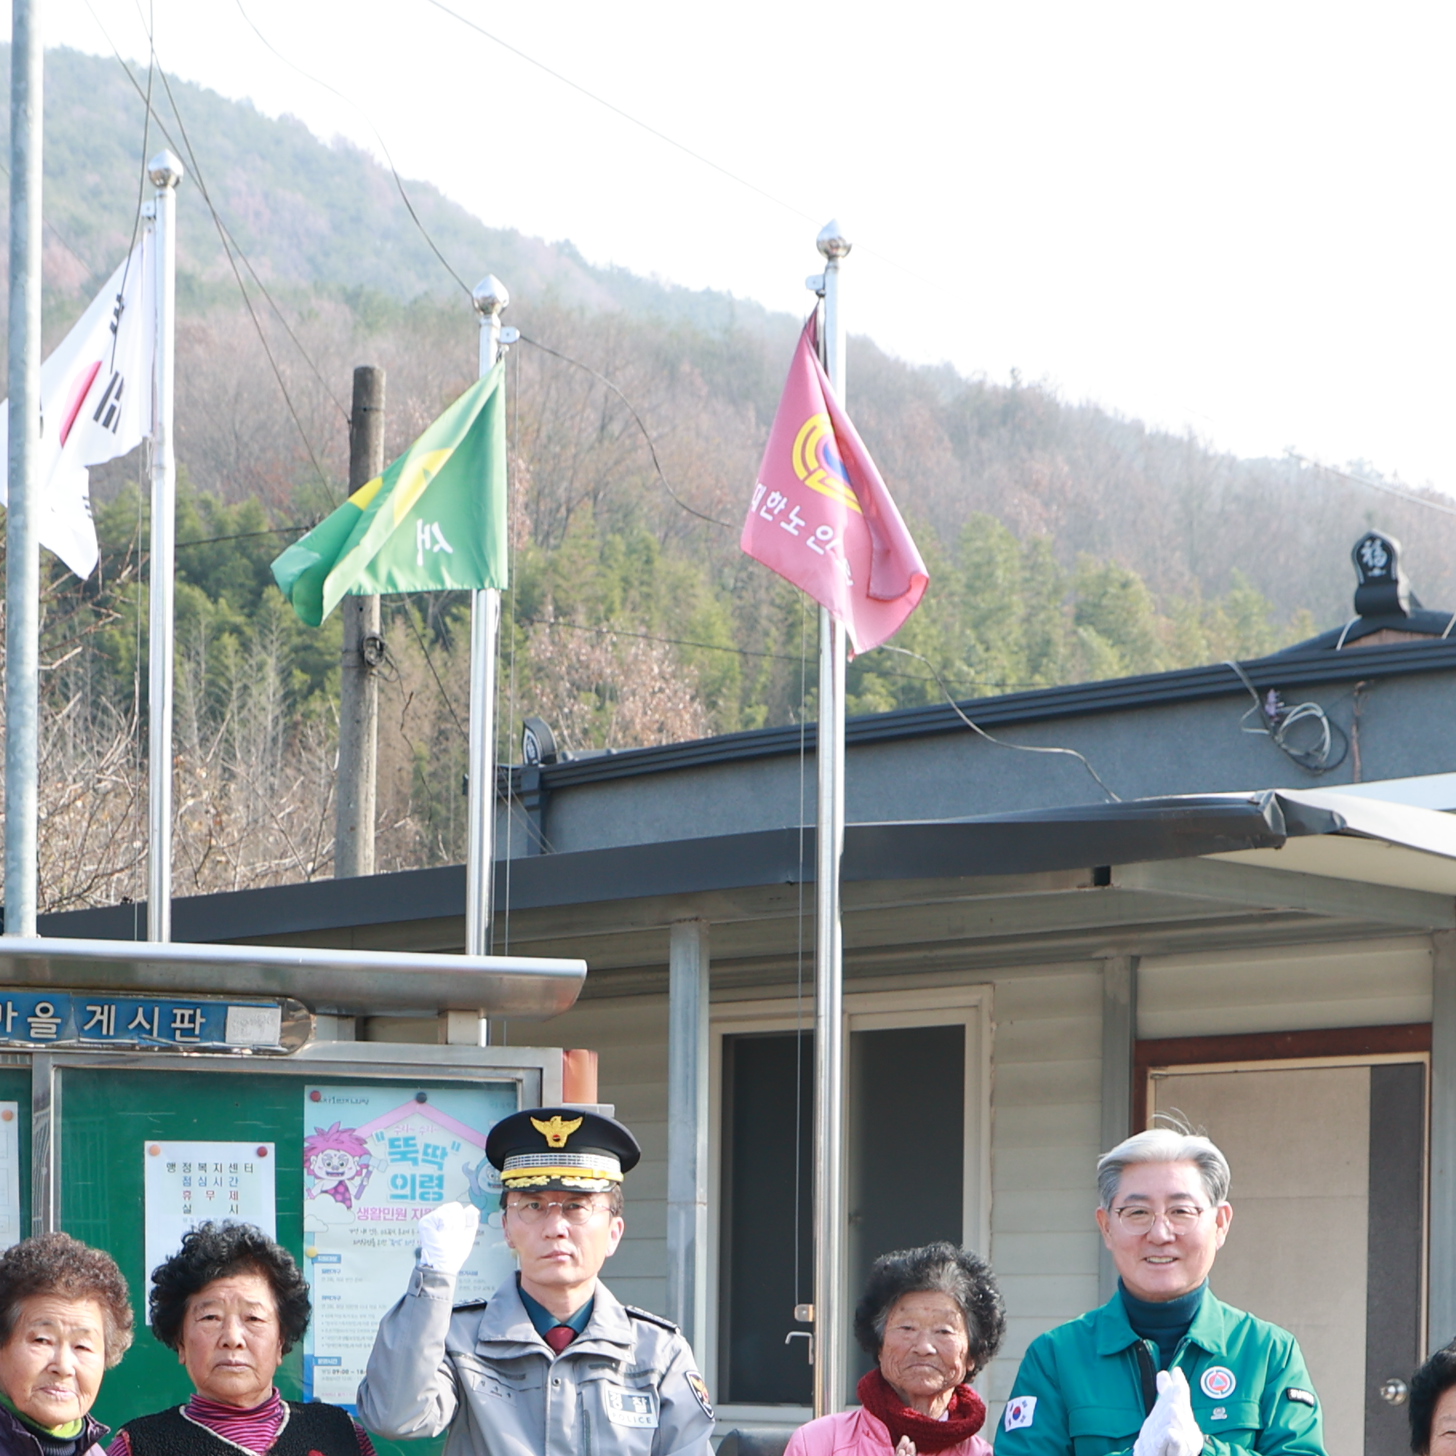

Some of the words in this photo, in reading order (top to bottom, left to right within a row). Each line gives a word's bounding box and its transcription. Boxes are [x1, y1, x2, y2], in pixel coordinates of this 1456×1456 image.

[82, 1001, 206, 1044] 게시판
[182, 1176, 239, 1188] 점심시간
[389, 1173, 445, 1203] 의령
[356, 1207, 408, 1222] 생활민원
[609, 1391, 648, 1413] 경찰
[612, 1413, 652, 1425] POLICE
